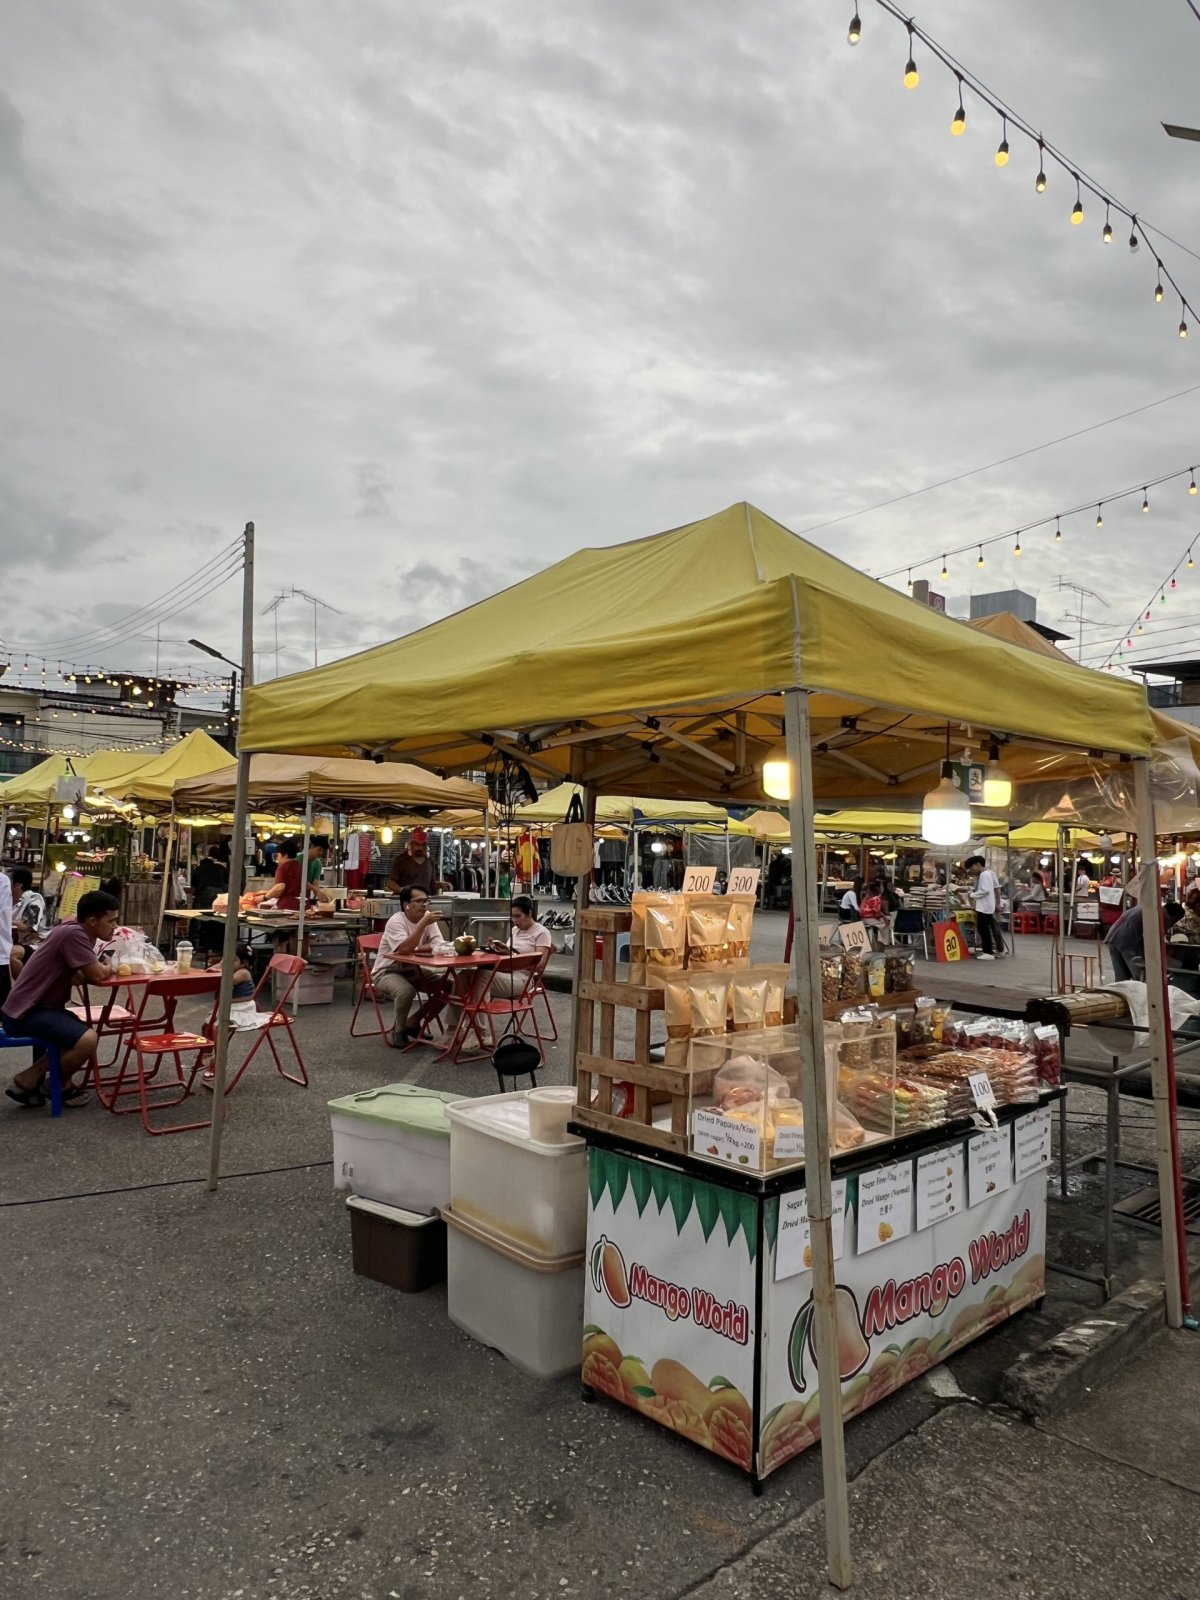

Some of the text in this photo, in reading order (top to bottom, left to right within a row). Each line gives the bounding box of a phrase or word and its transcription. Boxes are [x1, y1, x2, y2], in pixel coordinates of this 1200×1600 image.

[687, 875, 710, 892] 200
[731, 876, 753, 892] 300
[846, 930, 864, 947] 100
[973, 1080, 990, 1097] 100
[697, 1112, 715, 1125] Dried
[786, 1200, 803, 1210] Sugar
[782, 1216, 799, 1230] Dried
[864, 1209, 1030, 1338] Mango World
[631, 1263, 748, 1346] Mango World
